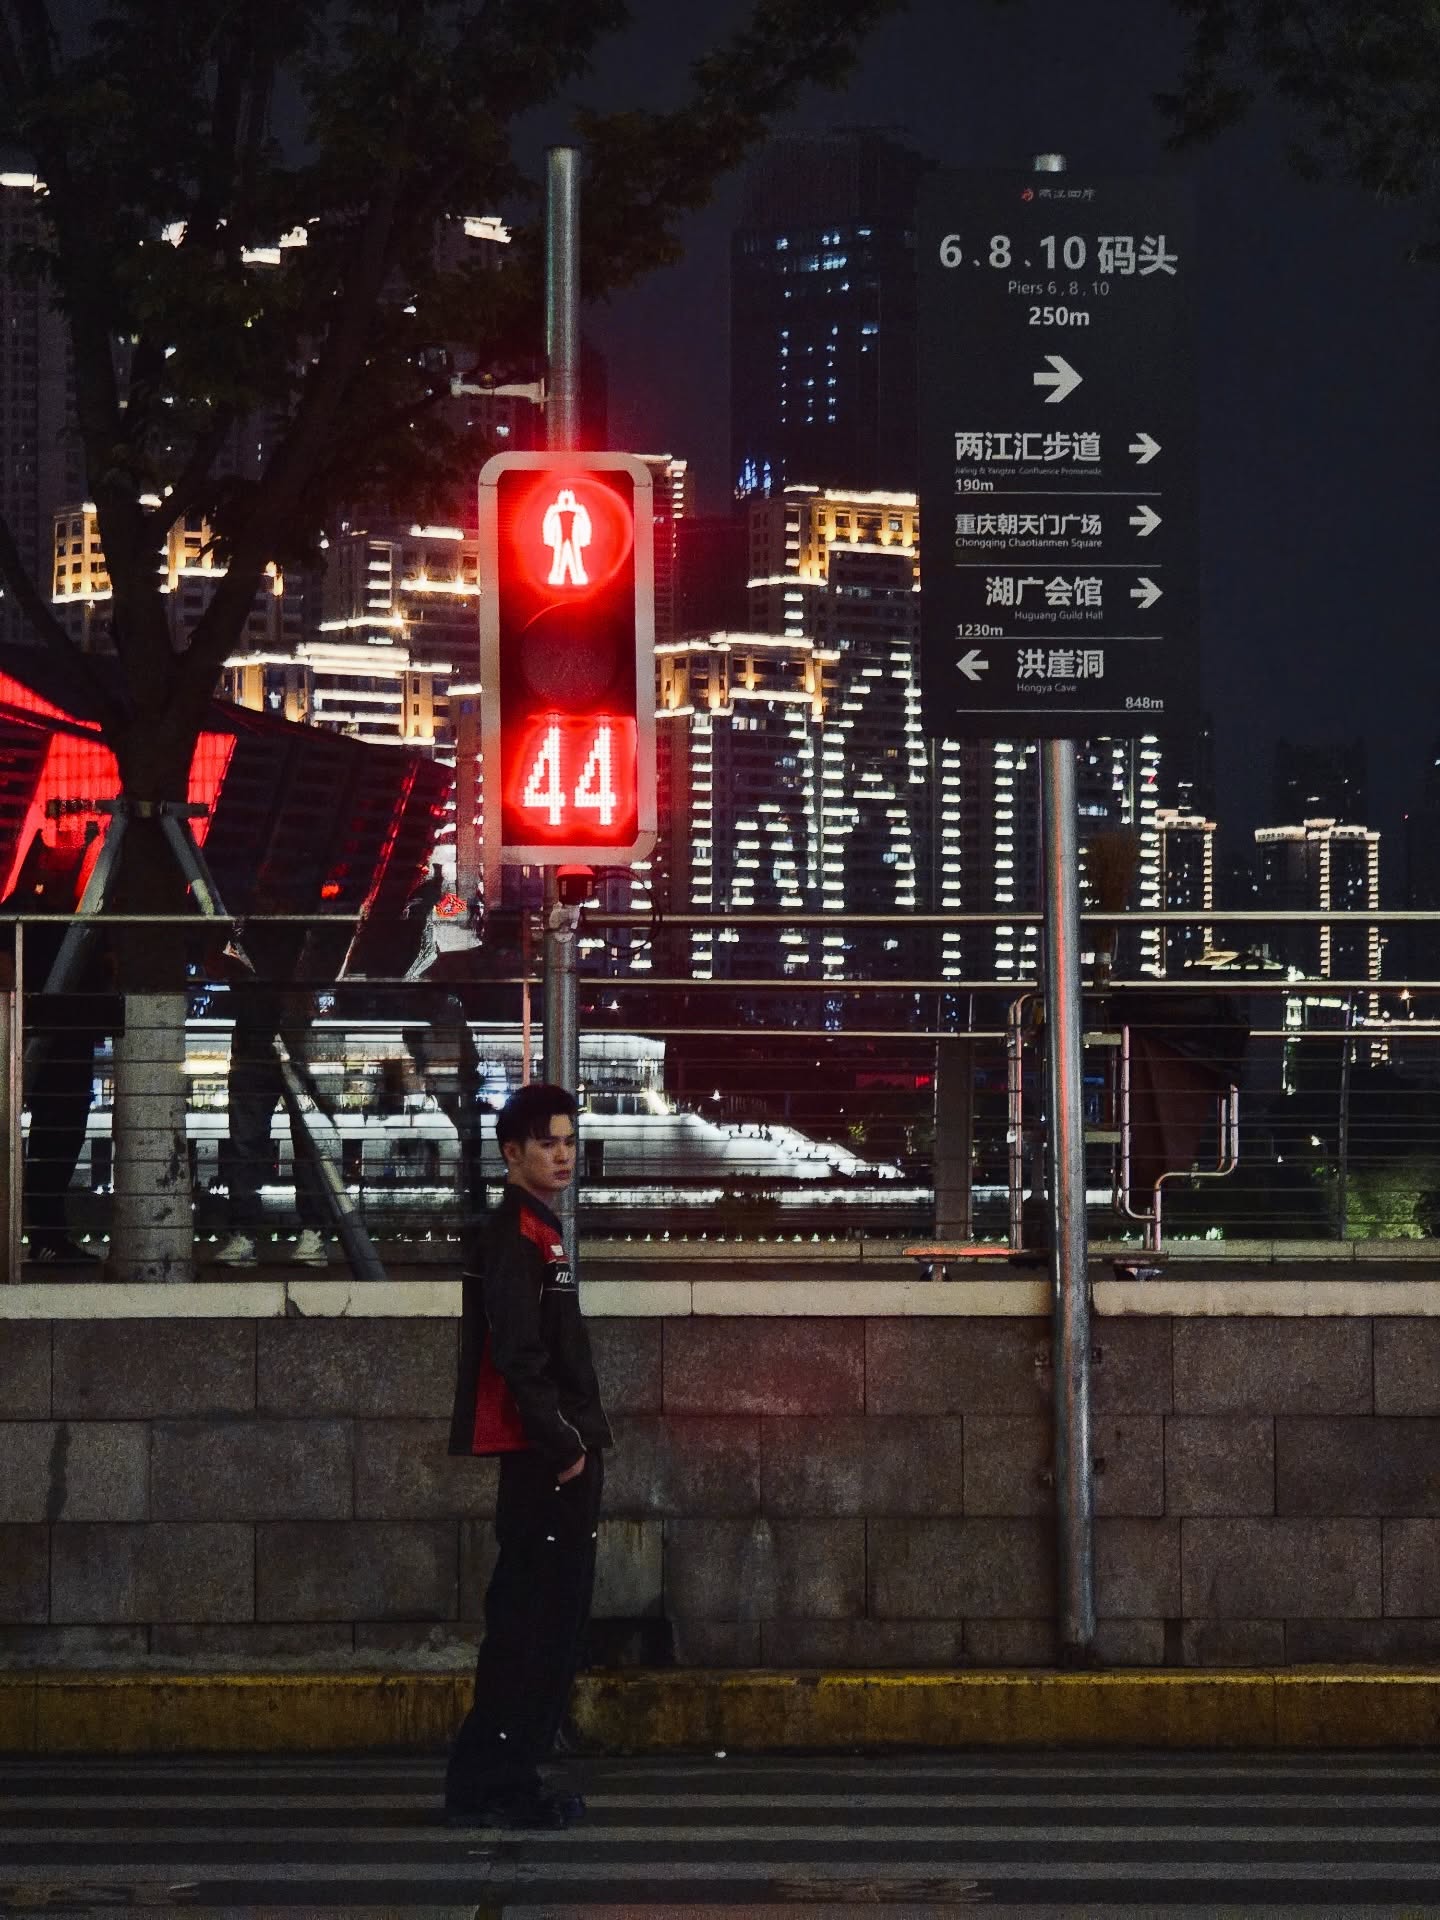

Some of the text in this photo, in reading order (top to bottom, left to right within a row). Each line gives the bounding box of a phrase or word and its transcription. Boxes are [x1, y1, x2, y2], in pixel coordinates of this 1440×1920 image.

[1007, 280, 1043, 295] Piers
[1092, 281, 1110, 296] 10
[1028, 306, 1090, 326] 250m
[954, 432, 1101, 462] 两江汇步道
[1018, 467, 1060, 476] Confluence
[955, 479, 994, 491] 190m
[954, 513, 1103, 536] 重庆朝天门广场
[955, 538, 1103, 549] Chongqing Chaotianmen Square
[985, 576, 1103, 606] 湖广会馆
[1014, 610, 1104, 621] Huguang Guild Hall
[956, 624, 1003, 636] 1230m
[1016, 648, 1105, 679] 洪崖洞
[1016, 683, 1078, 694] Hongya Cave
[1125, 697, 1164, 709] 848m
[523, 726, 617, 826] 44
